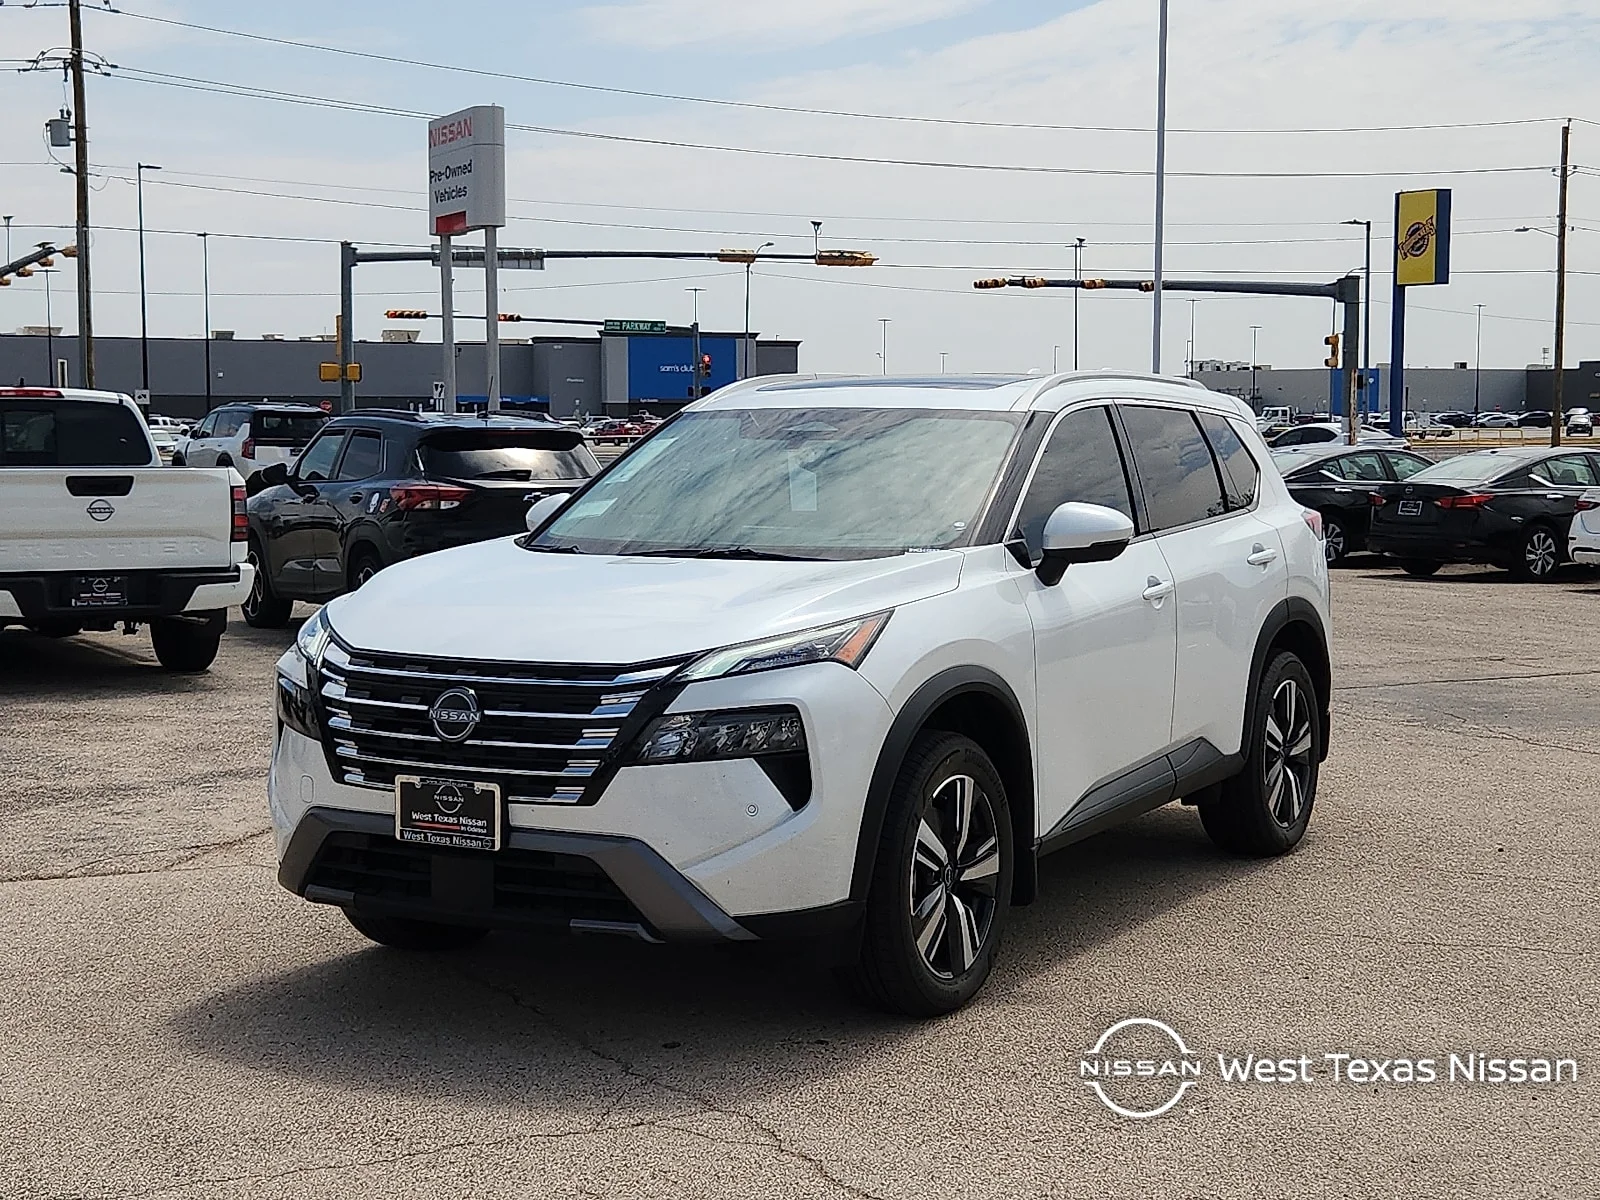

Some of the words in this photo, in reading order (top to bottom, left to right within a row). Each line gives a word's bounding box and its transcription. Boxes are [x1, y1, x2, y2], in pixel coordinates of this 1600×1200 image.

[429, 117, 472, 148] NISSAN
[429, 159, 472, 184] Pre-Owned
[434, 185, 468, 204] Vehicles
[621, 321, 652, 330] PARKWAY
[428, 708, 481, 723] NISSAN
[433, 794, 464, 803] NISSAN
[411, 811, 432, 821] West
[433, 814, 458, 824] Texas
[459, 816, 487, 827] Nissan
[403, 830, 425, 841] West
[427, 833, 451, 844] Texas
[452, 837, 482, 848] Nissan
